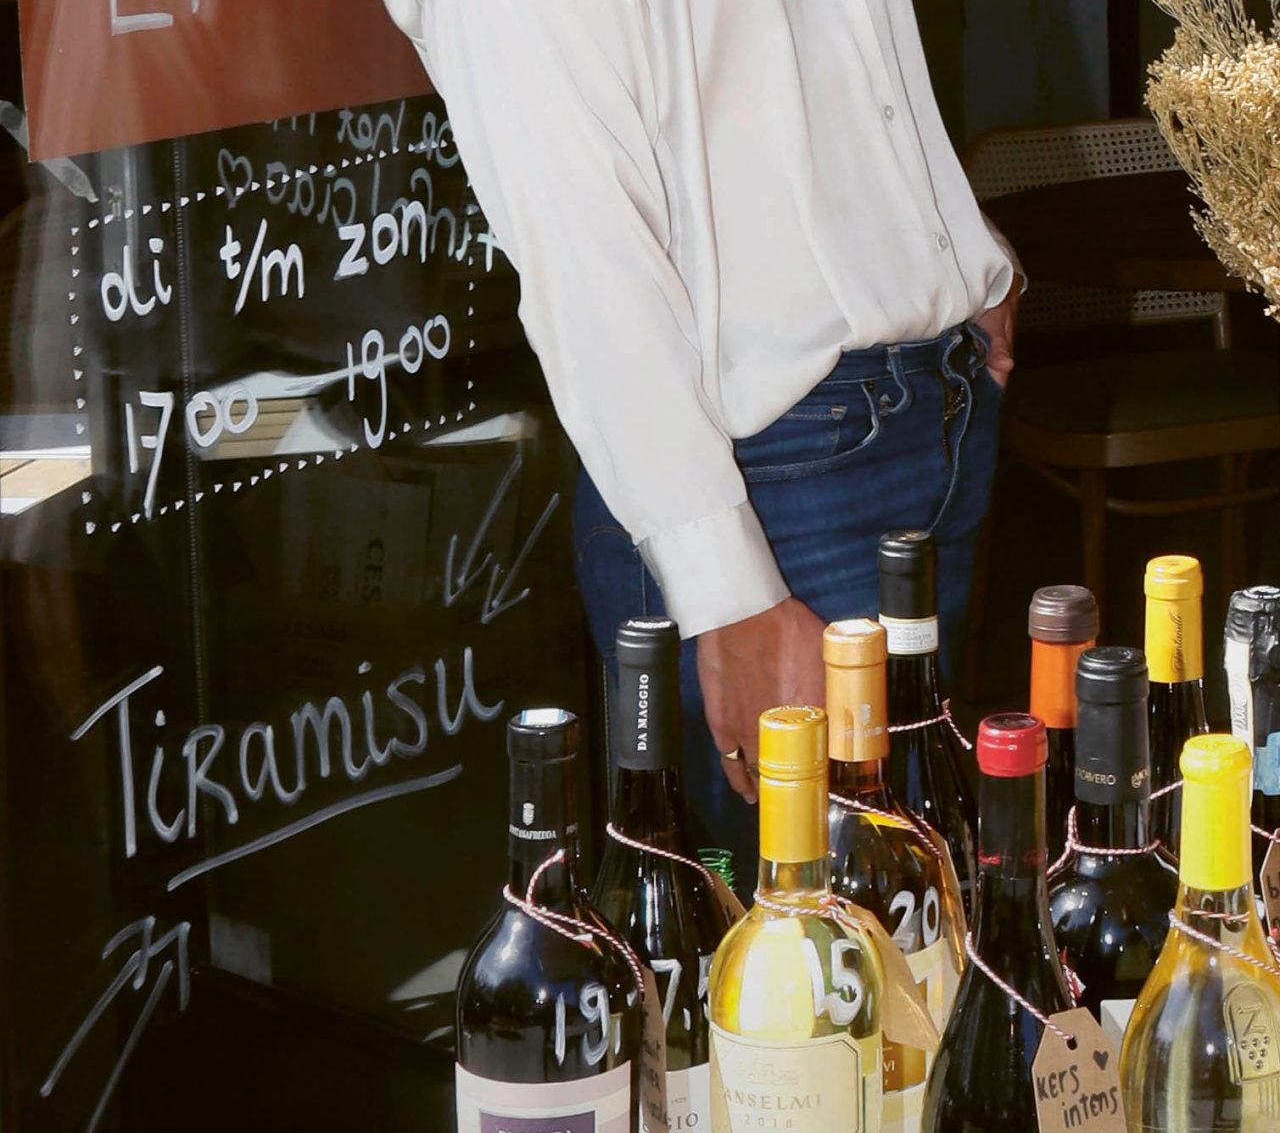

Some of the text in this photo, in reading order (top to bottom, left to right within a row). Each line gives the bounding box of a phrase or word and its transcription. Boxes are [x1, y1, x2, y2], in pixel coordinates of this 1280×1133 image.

[100, 237, 172, 322] di
[219, 218, 305, 316] t/m
[637, 674, 649, 751] DA MAGGIO
[723, 1089, 822, 1112] ANSELMI
